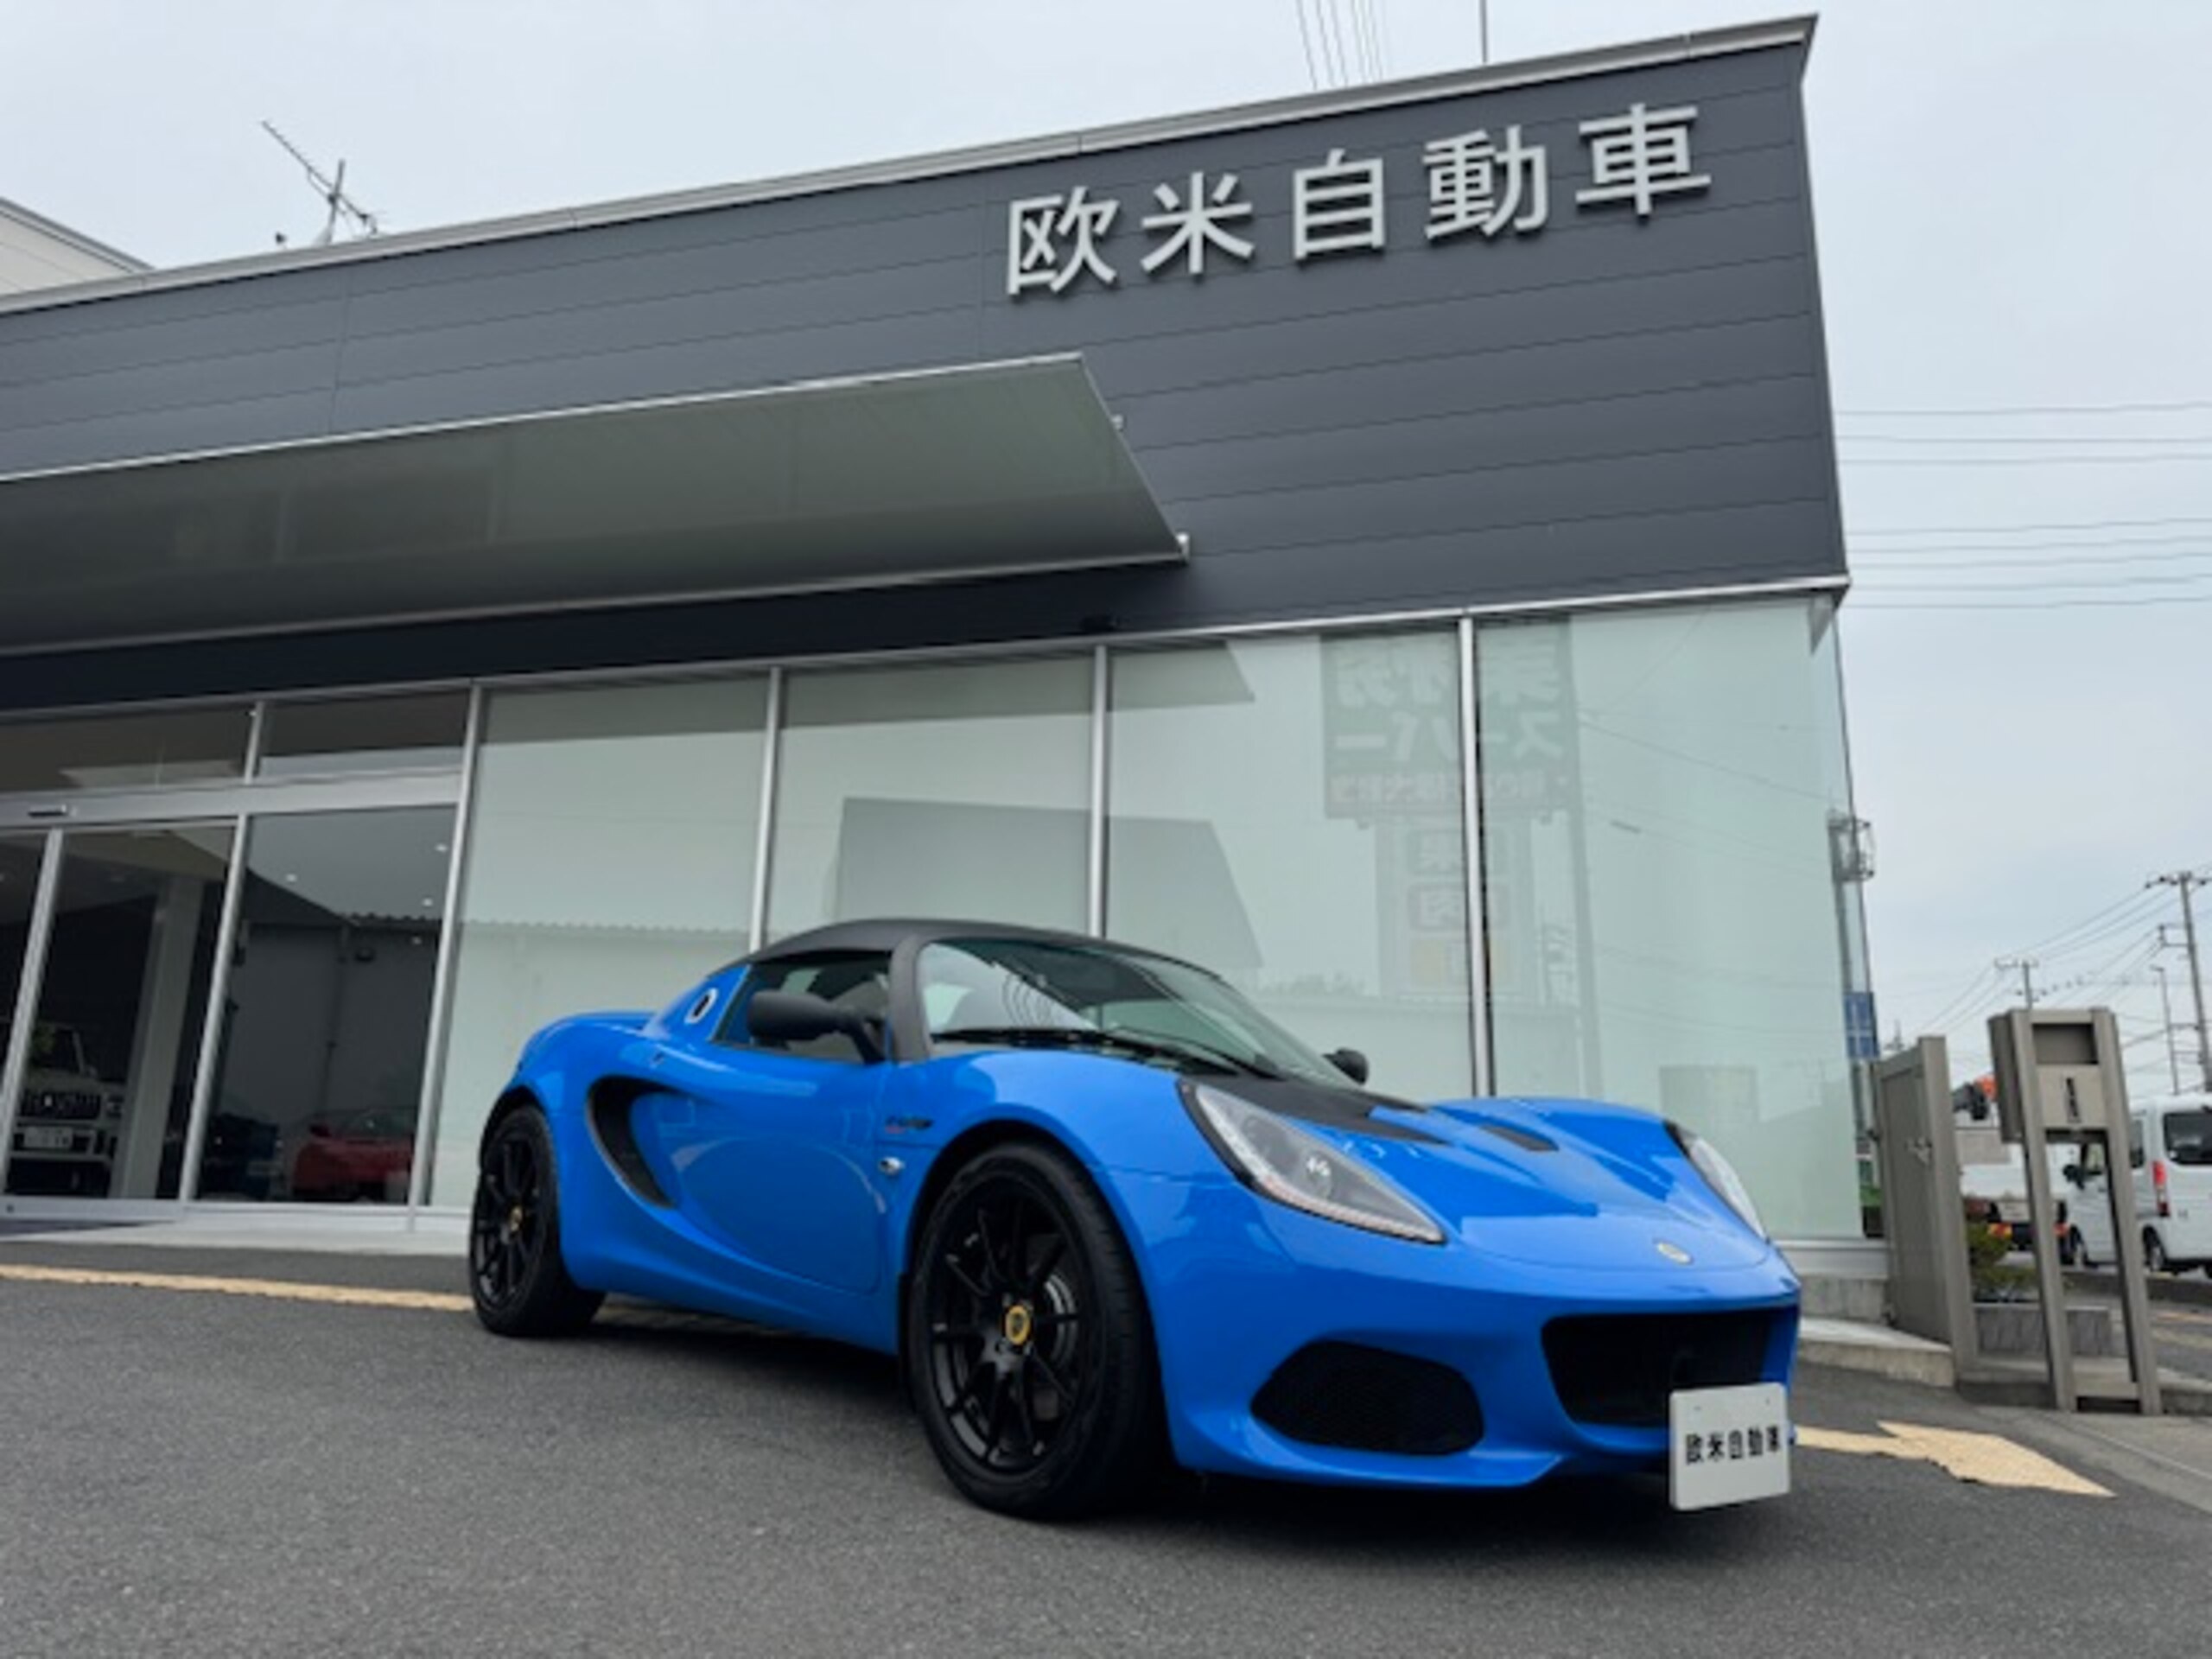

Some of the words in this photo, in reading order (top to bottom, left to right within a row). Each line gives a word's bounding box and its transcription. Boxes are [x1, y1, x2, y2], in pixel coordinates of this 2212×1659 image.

[1006, 102, 1712, 296] 欧米自動車
